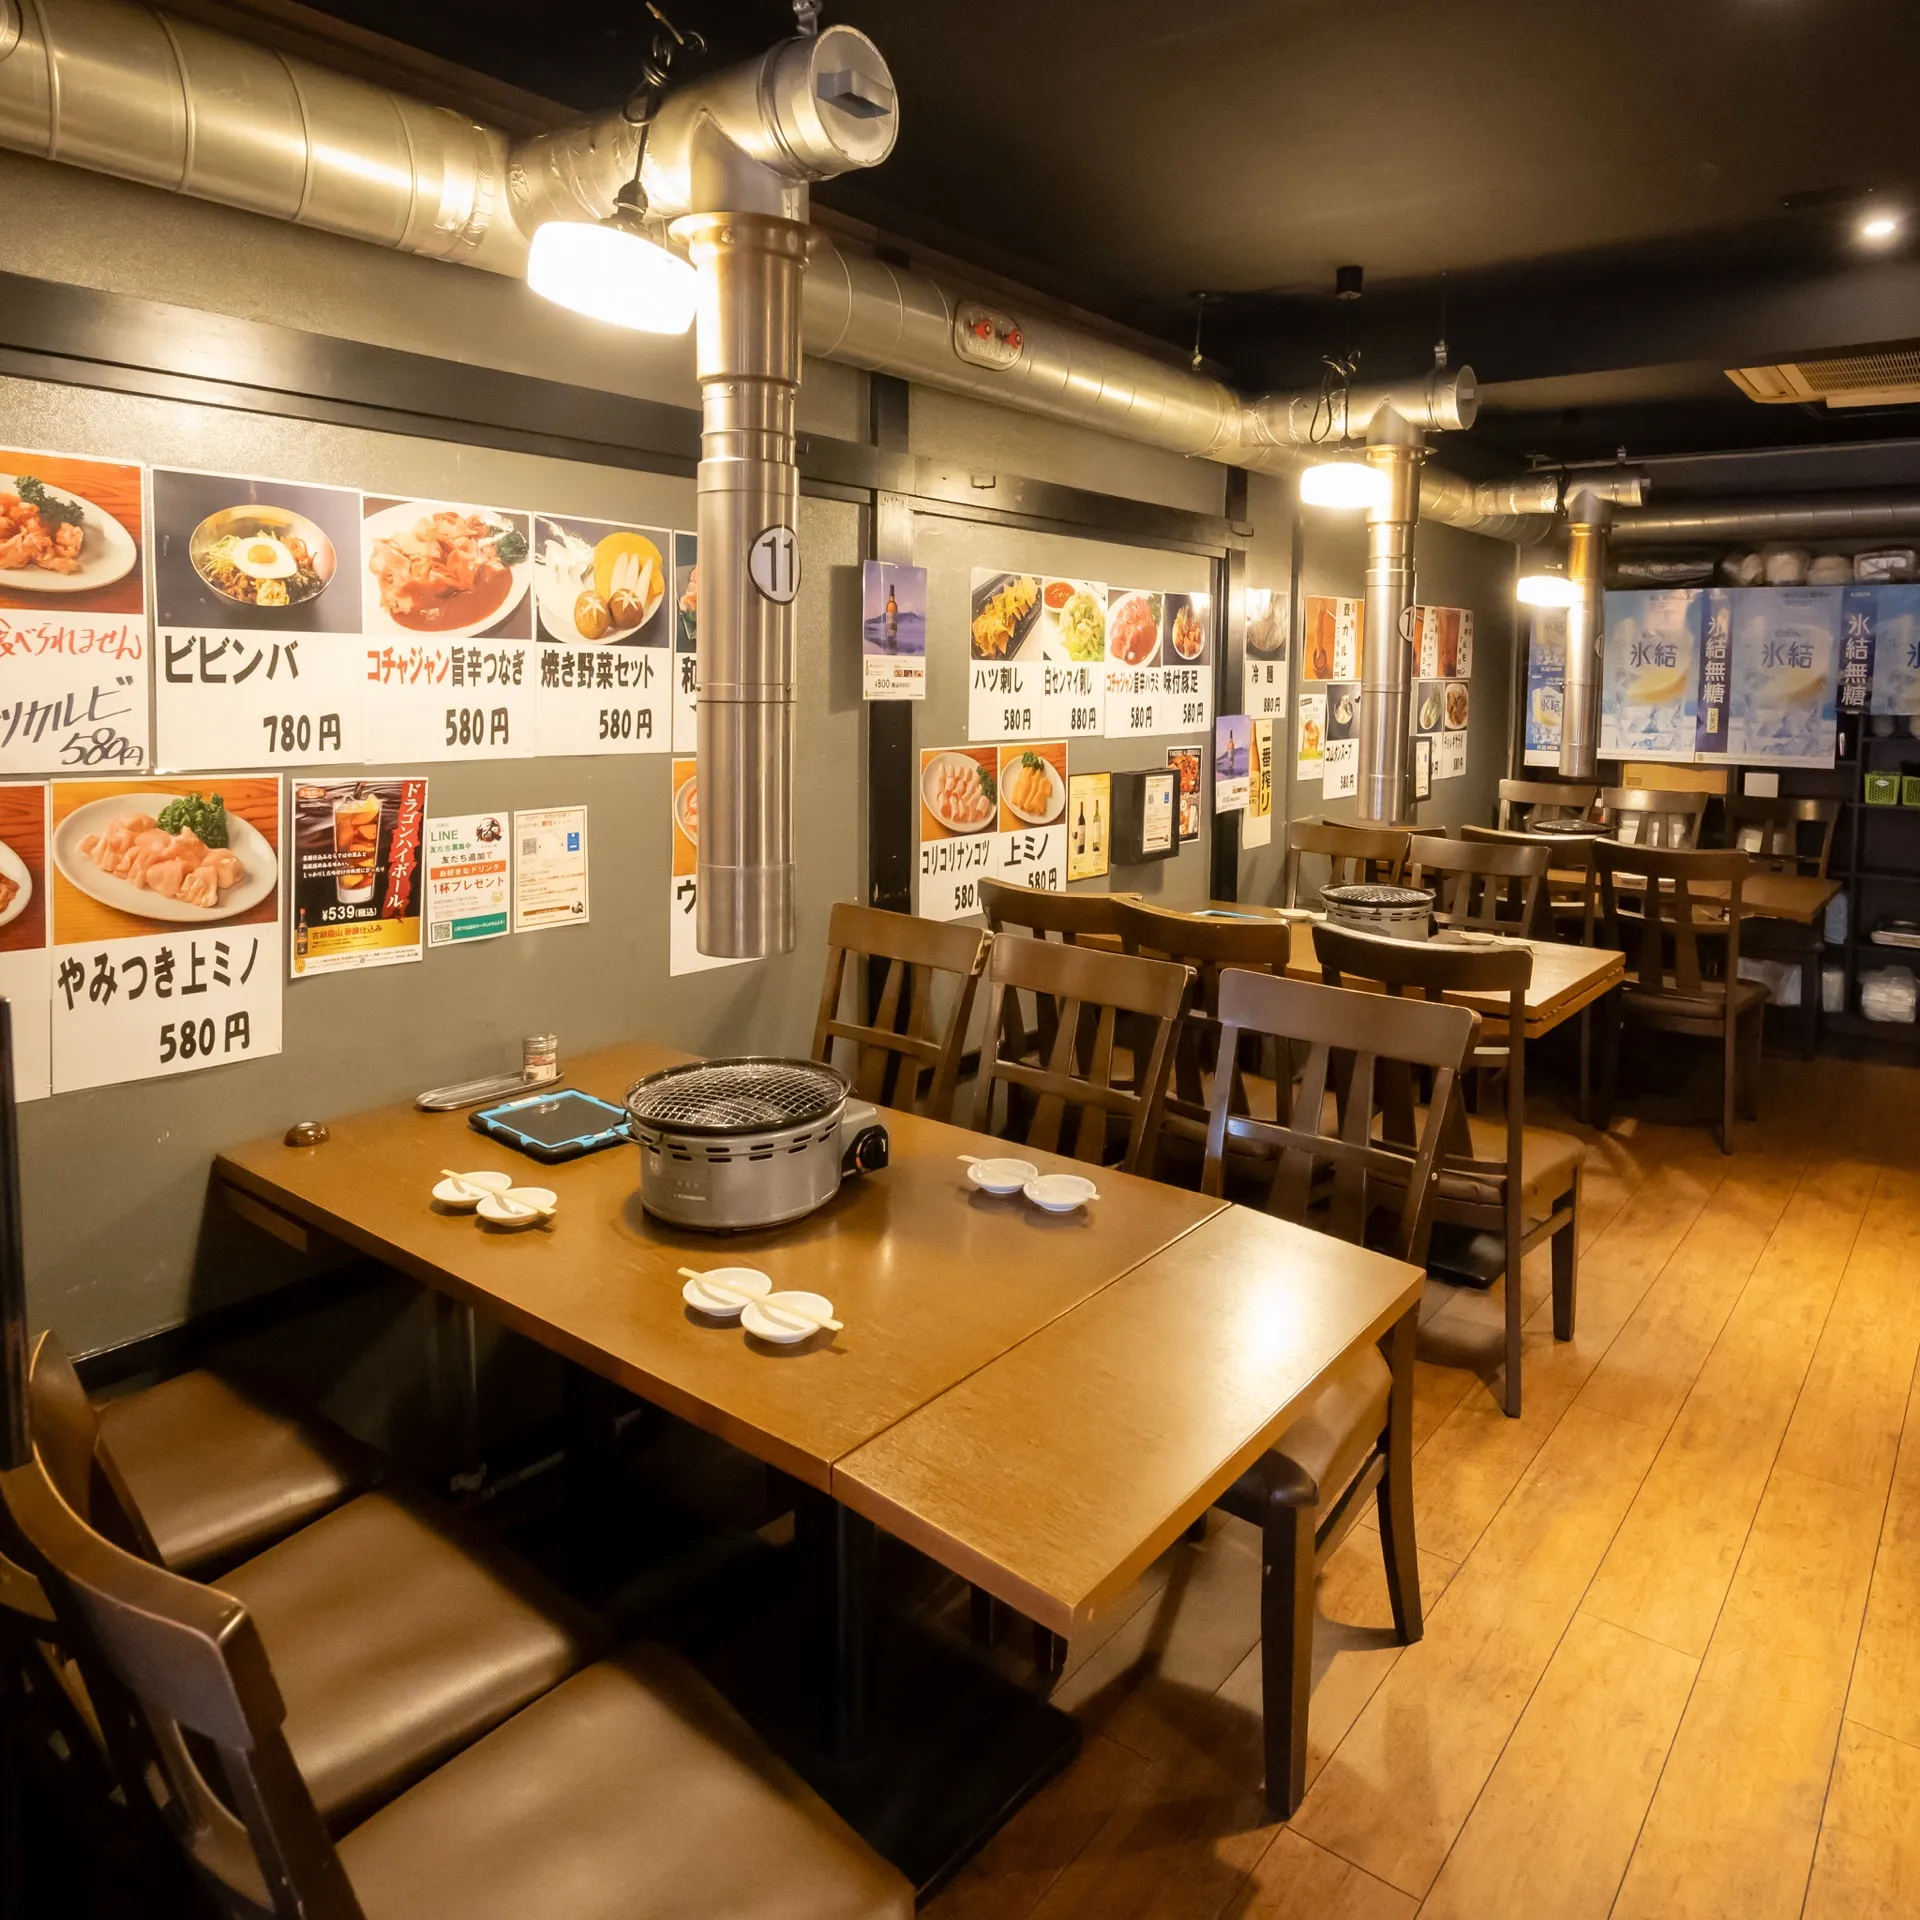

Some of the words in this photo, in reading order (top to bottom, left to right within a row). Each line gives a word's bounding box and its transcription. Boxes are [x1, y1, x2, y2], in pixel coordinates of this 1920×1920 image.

[762, 536, 794, 593] 11
[1405, 610, 1414, 637] 1
[164, 635, 299, 685] ビビンバ
[367, 646, 525, 687] コチャジャン旨辛つなぎ
[541, 650, 655, 689] 焼き野菜セット
[1630, 642, 1678, 668] 氷結
[1703, 616, 1726, 704] 氷結無糖
[1762, 641, 1814, 669] 氷結
[1841, 613, 1870, 706] 氷結無糖
[974, 667, 1024, 695] ハツ刺し
[1163, 670, 1199, 695] 味付豚足
[446, 707, 509, 746] 580円
[599, 709, 653, 740] 580円
[1004, 708, 1031, 731] 580円
[1071, 707, 1096, 731] 880円
[1130, 706, 1153, 729] 580円
[1182, 702, 1204, 724] 580円
[263, 713, 341, 752] 780円
[386, 783, 421, 908] ドラゴンハイボール
[431, 830, 459, 842] LINE
[1004, 833, 1049, 867] 上ミノ
[441, 851, 493, 865] 友だち追加で
[922, 840, 990, 875] コリコリナンコツ
[433, 876, 504, 895] 1杯プレゼント
[955, 884, 979, 911] 580
[58, 938, 258, 1010] やみつき上ミノ
[159, 1010, 250, 1064] 580円
